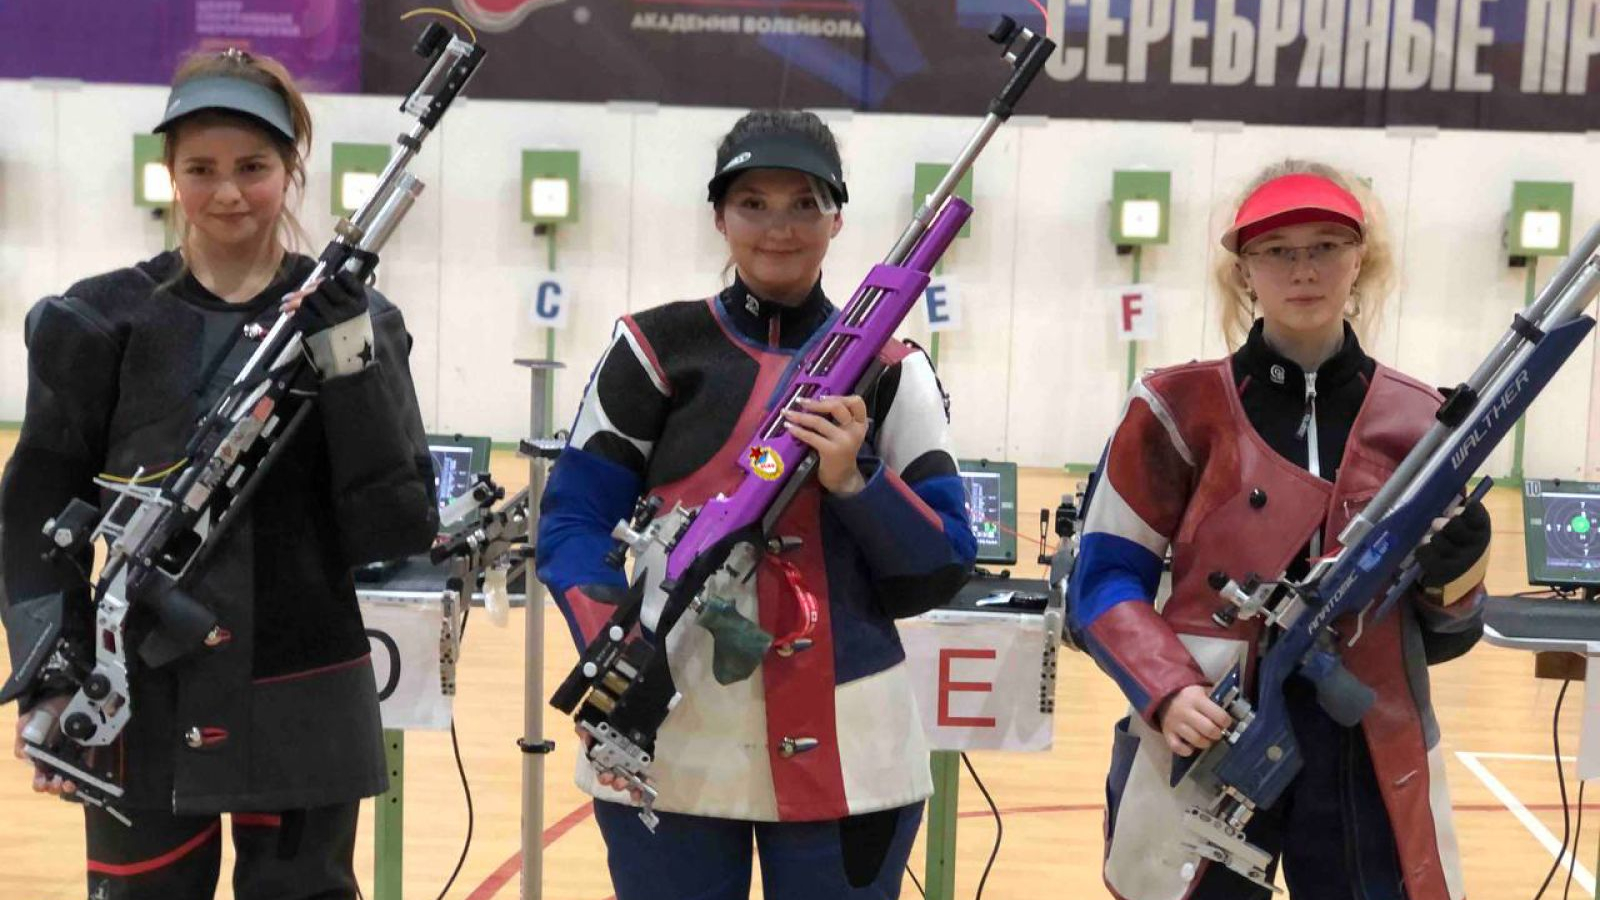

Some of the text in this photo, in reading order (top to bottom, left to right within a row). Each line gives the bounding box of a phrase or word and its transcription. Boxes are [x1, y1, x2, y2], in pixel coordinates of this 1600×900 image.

[631, 12, 865, 38] АКАДЕМИЯ ВОЛЕЙБОЛА
[1044, 0, 1495, 92] СЕРЕБРЯНЫЕ
[536, 281, 562, 319] C
[925, 285, 950, 323] E
[1122, 293, 1143, 332] F
[1450, 369, 1530, 471] WALTHER
[937, 648, 997, 728] E
